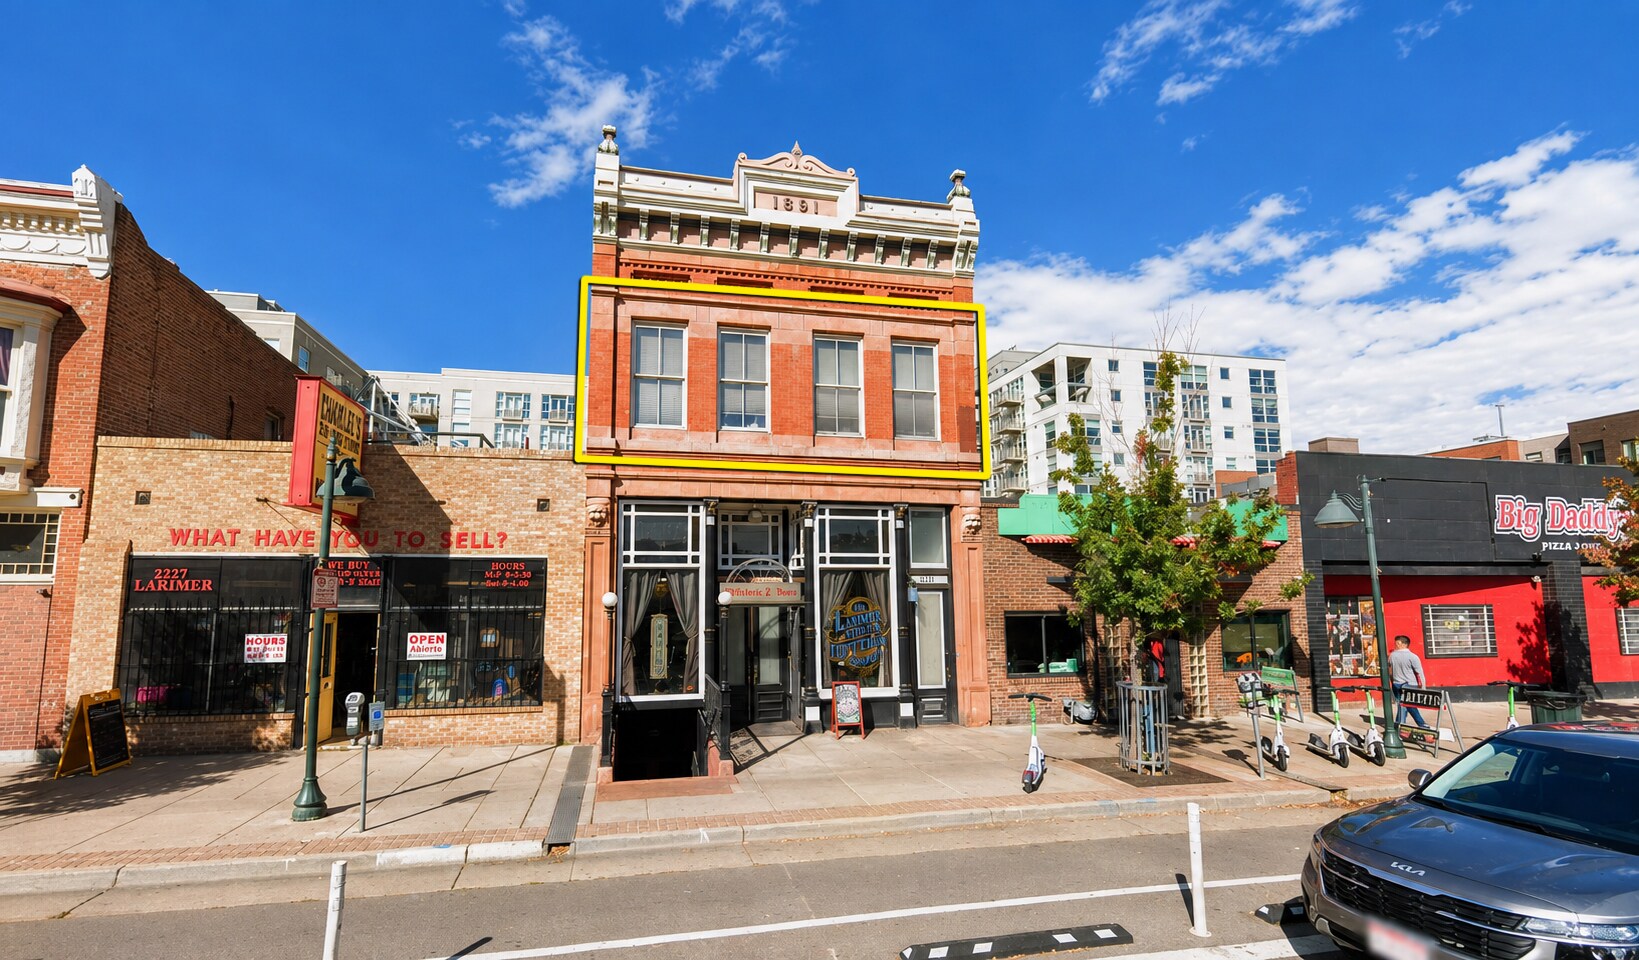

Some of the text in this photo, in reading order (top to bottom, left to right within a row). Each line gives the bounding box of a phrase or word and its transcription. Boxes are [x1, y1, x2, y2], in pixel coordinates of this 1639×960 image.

[1496, 496, 1630, 542] Big Daddy
[169, 528, 508, 549] WHAT HAVE YOU TO SELL?
[1541, 542, 1572, 551] PIZZA
[328, 561, 370, 570] WE BUY
[491, 562, 525, 570] HOURS
[154, 568, 188, 579] 2227
[134, 579, 213, 591] LARIMER
[765, 588, 771, 597] 2
[246, 637, 286, 646] HOURS
[409, 635, 445, 644] OPEN
[1391, 862, 1425, 876] KIA
